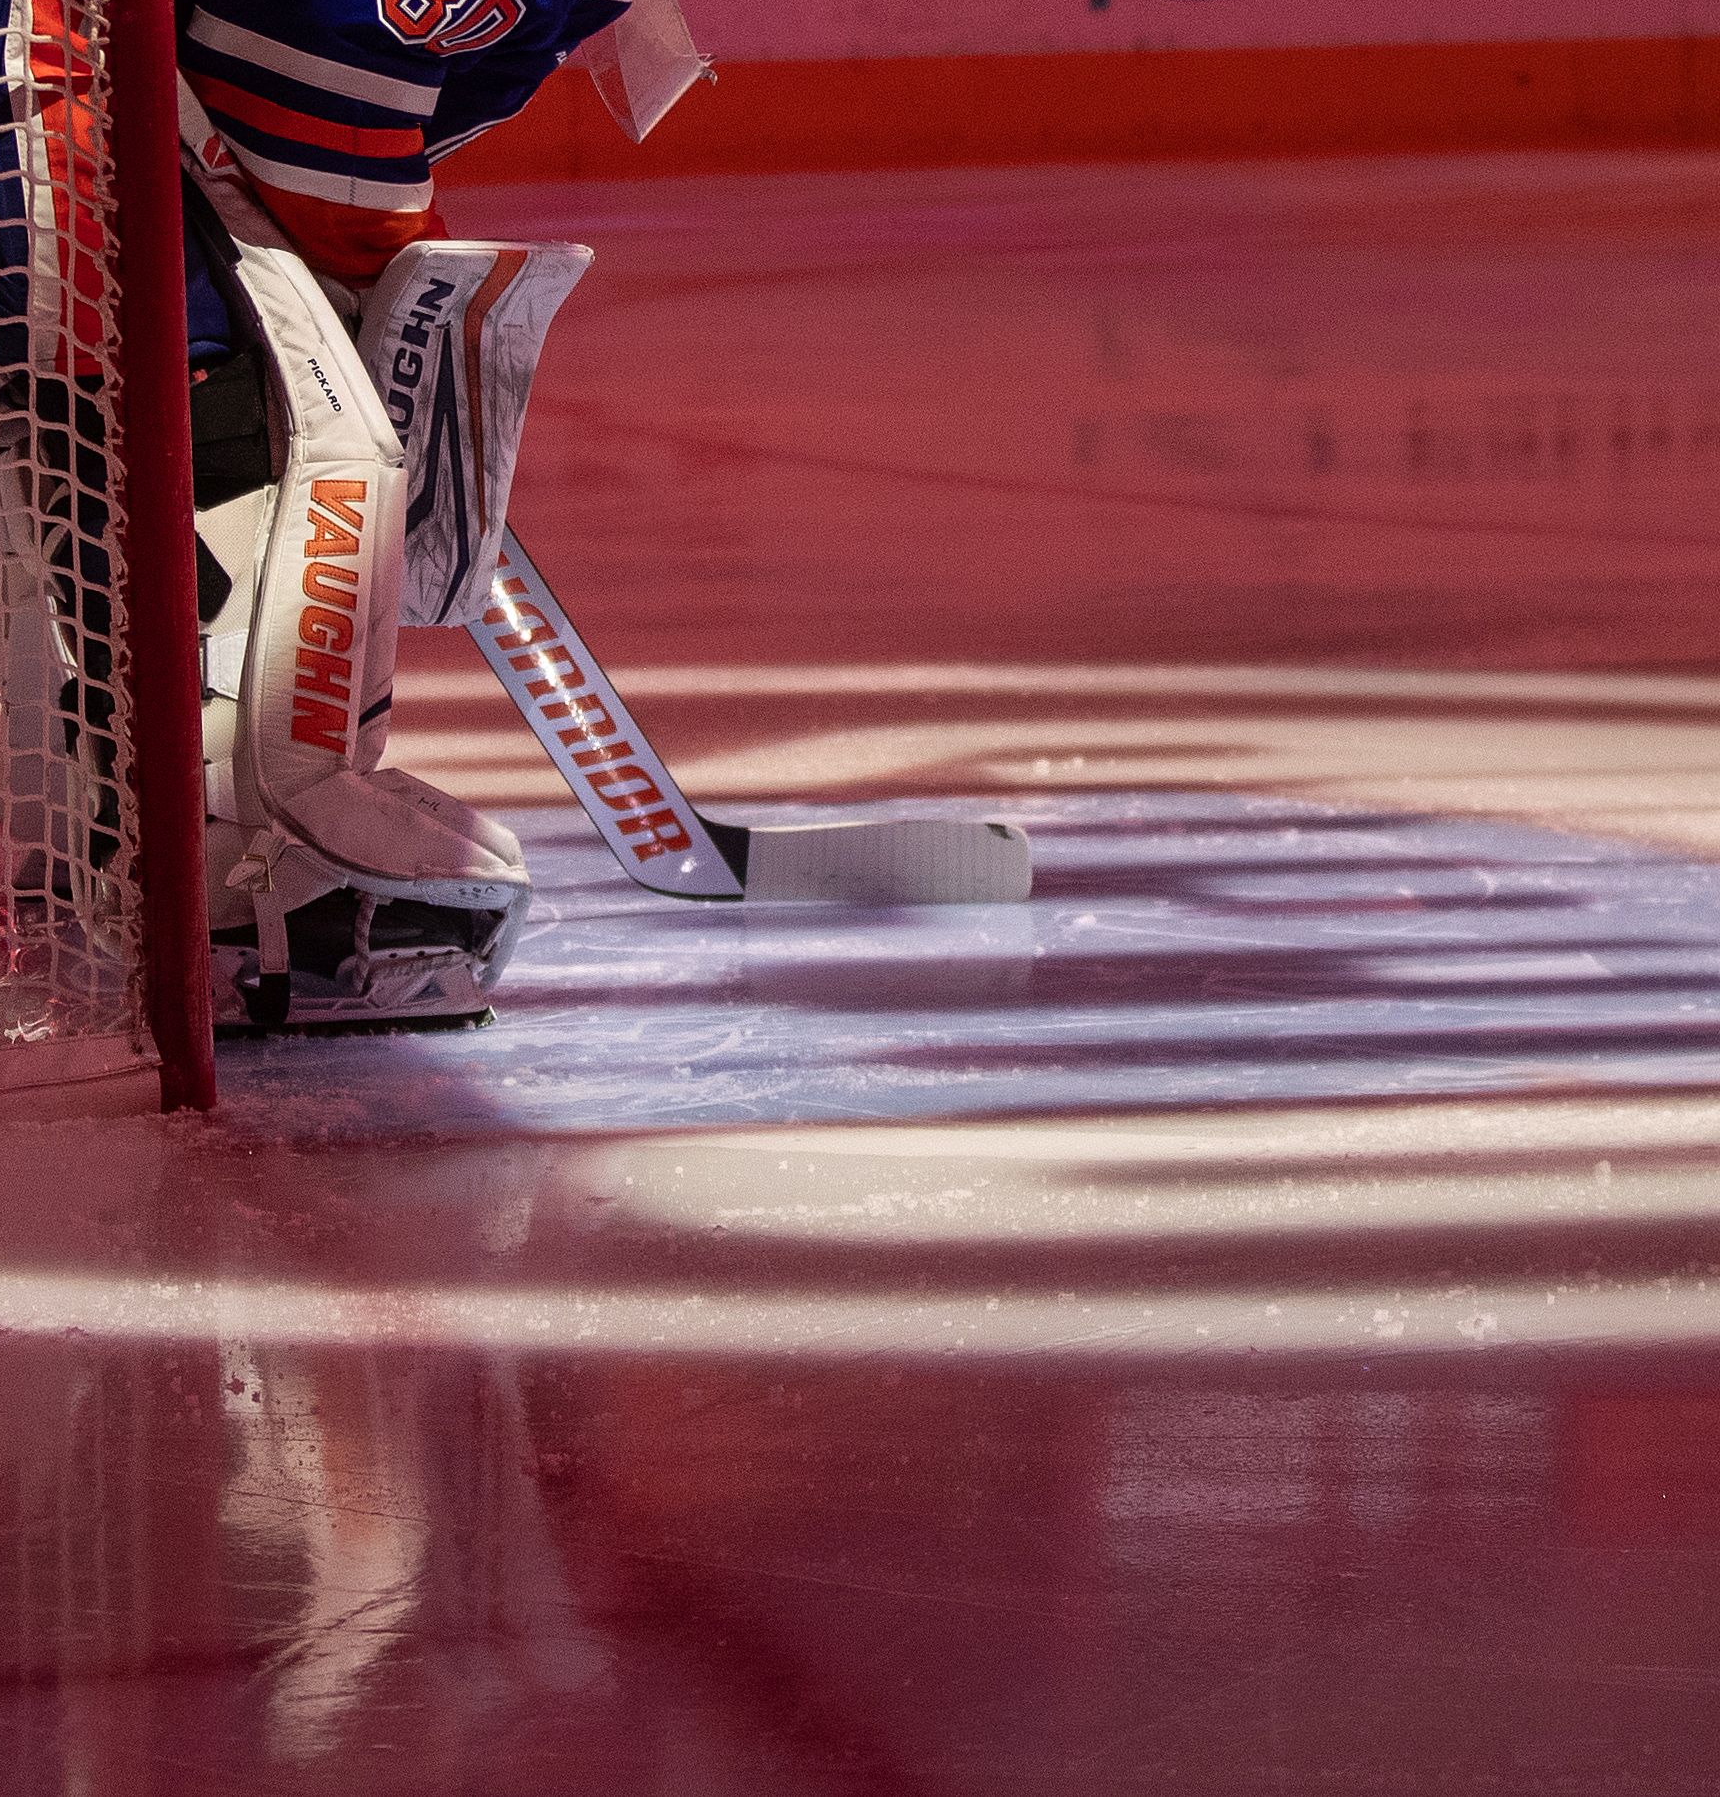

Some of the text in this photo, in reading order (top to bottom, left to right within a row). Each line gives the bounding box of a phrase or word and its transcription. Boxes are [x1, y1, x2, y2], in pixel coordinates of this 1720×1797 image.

[307, 357, 343, 413] PICKARD
[387, 277, 457, 450] UGHN
[290, 478, 369, 757] VAUGHN
[481, 550, 693, 864] ARRIOR
